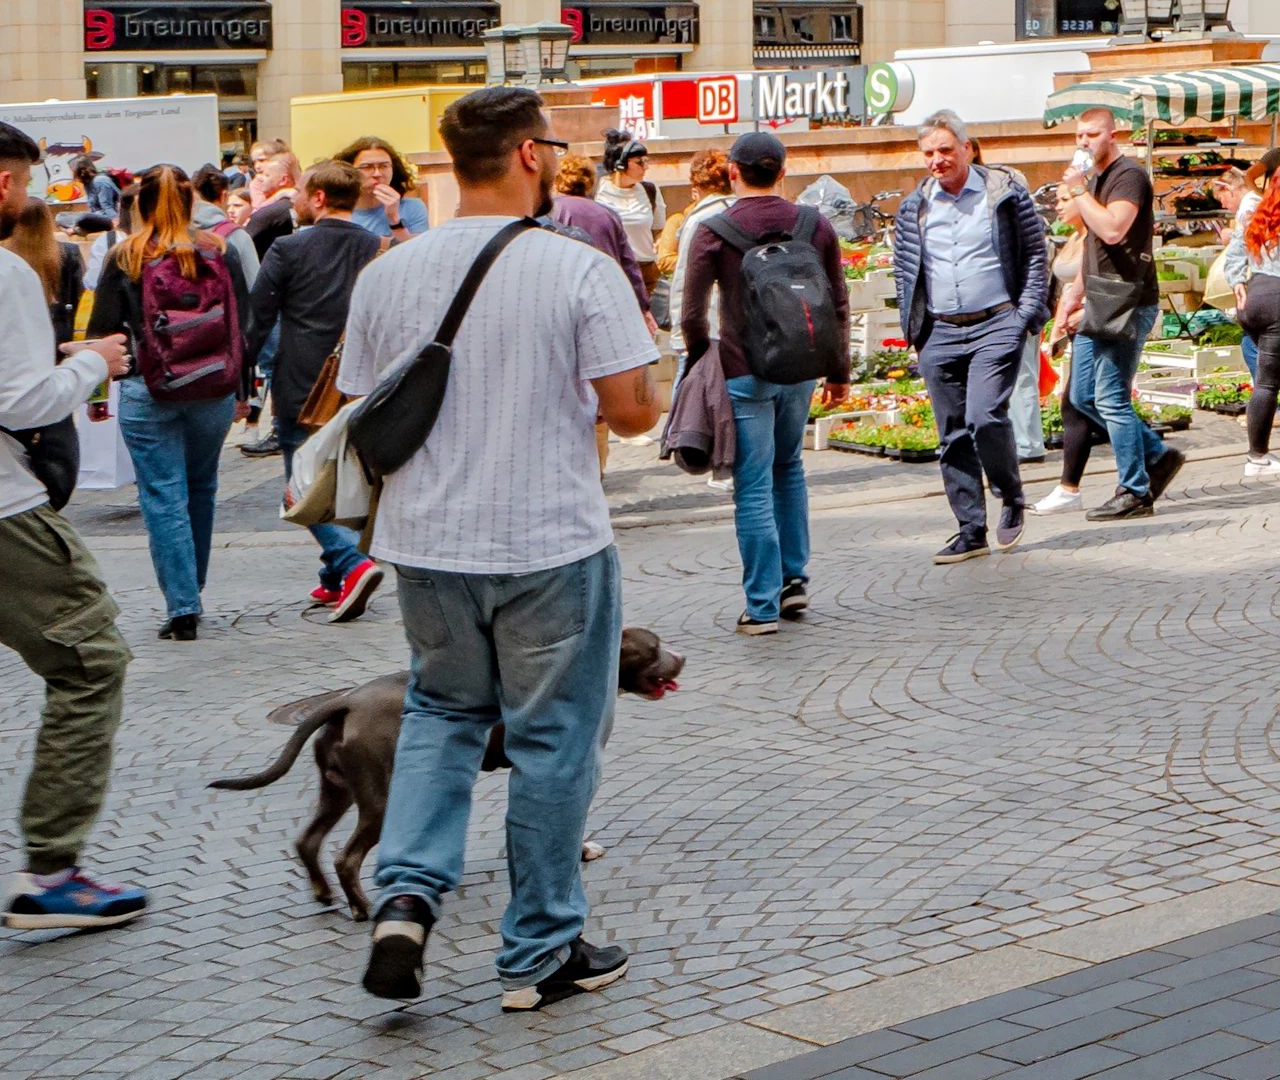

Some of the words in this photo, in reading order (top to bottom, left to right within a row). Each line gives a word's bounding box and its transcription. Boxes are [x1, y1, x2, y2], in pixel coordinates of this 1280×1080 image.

[125, 14, 269, 39] breuninger
[375, 15, 499, 39] breuninger
[590, 13, 698, 37] breuninger
[703, 84, 731, 116] DB
[758, 71, 848, 117] Markt
[870, 69, 891, 107] S
[13, 114, 86, 124] Molkereiprodukte
[104, 110, 121, 118] dem
[124, 109, 158, 119] Torgauer
[161, 107, 181, 115] Land
